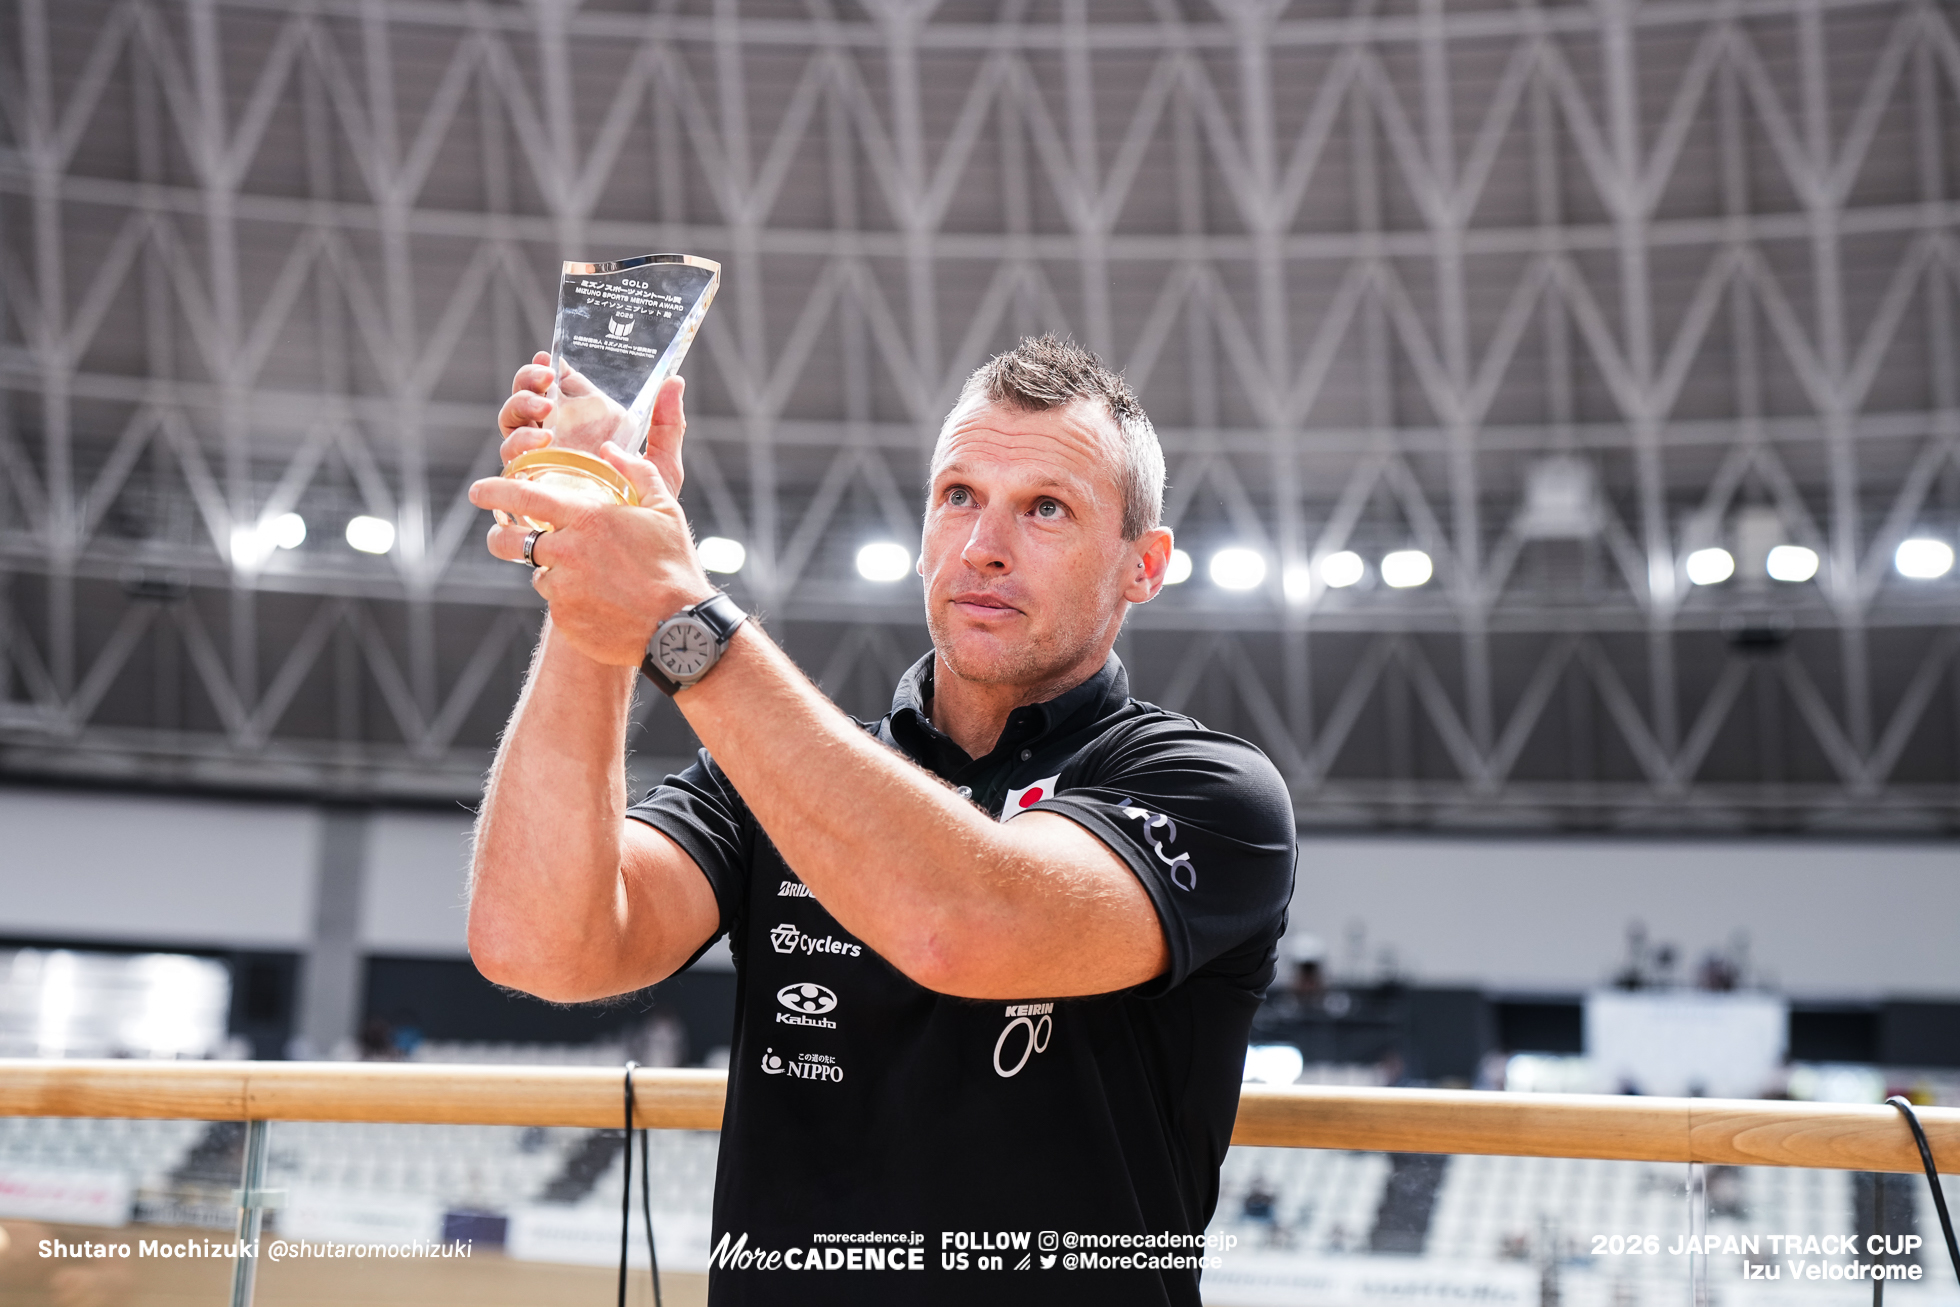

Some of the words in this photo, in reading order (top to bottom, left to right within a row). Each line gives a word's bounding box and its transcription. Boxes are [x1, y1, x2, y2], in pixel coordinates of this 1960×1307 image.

[622, 278, 648, 289] GOLD
[575, 286, 601, 296] MIZUNO
[602, 292, 629, 302] SPORTS
[630, 296, 658, 307] MENTOR
[658, 302, 684, 312] AWARD
[800, 934, 862, 957] Cyclers
[1004, 1003, 1054, 1017] KEIRIN
[776, 1012, 837, 1029] Kabuto
[798, 1053, 836, 1064] この道の先に
[786, 1060, 844, 1082] NIPPO
